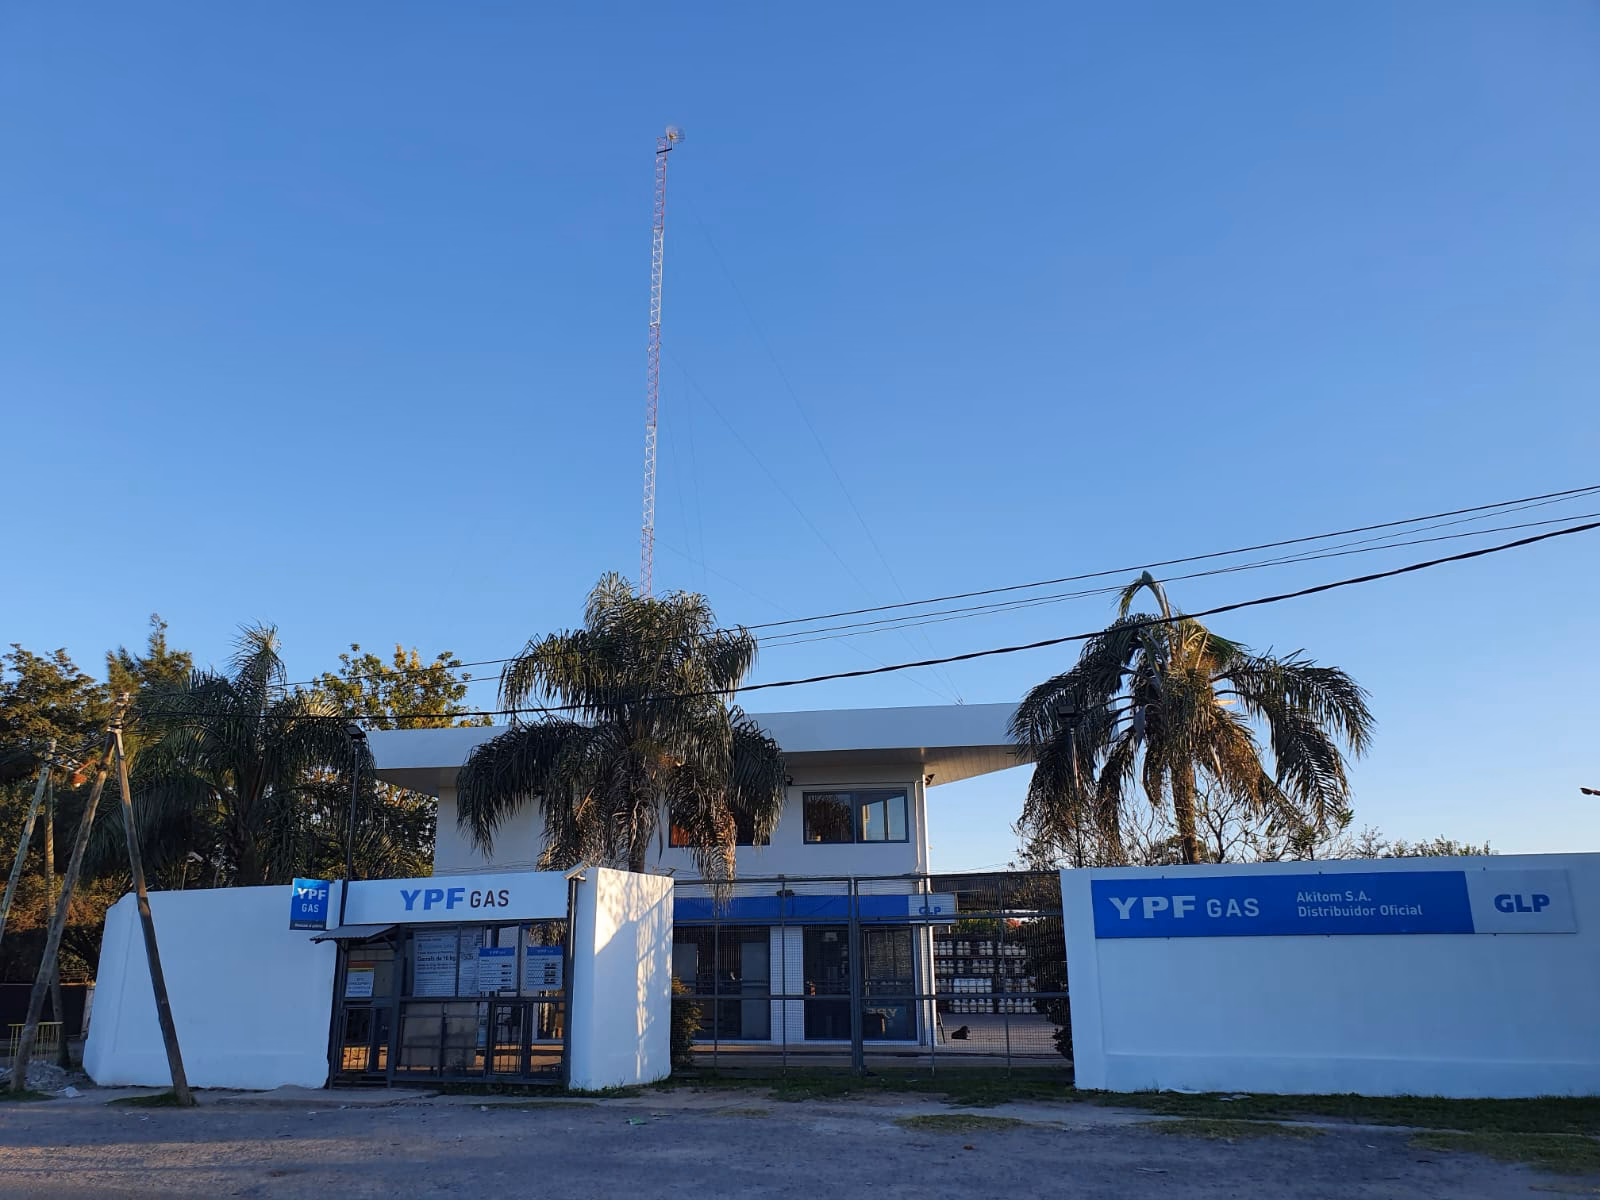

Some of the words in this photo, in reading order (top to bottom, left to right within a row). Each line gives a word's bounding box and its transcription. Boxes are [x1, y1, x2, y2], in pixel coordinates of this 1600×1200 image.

[297, 887, 327, 900] YPF
[400, 887, 465, 911] YPF
[470, 889, 510, 909] GAS
[1296, 890, 1342, 903] Akitom
[1346, 890, 1372, 903] S.A.
[301, 903, 320, 913] GAS
[1108, 895, 1197, 920] YPF
[1207, 898, 1260, 918] GAS
[1298, 904, 1376, 918] Distribuidor
[1380, 903, 1423, 917] Oficial
[1494, 894, 1550, 914] GLP
